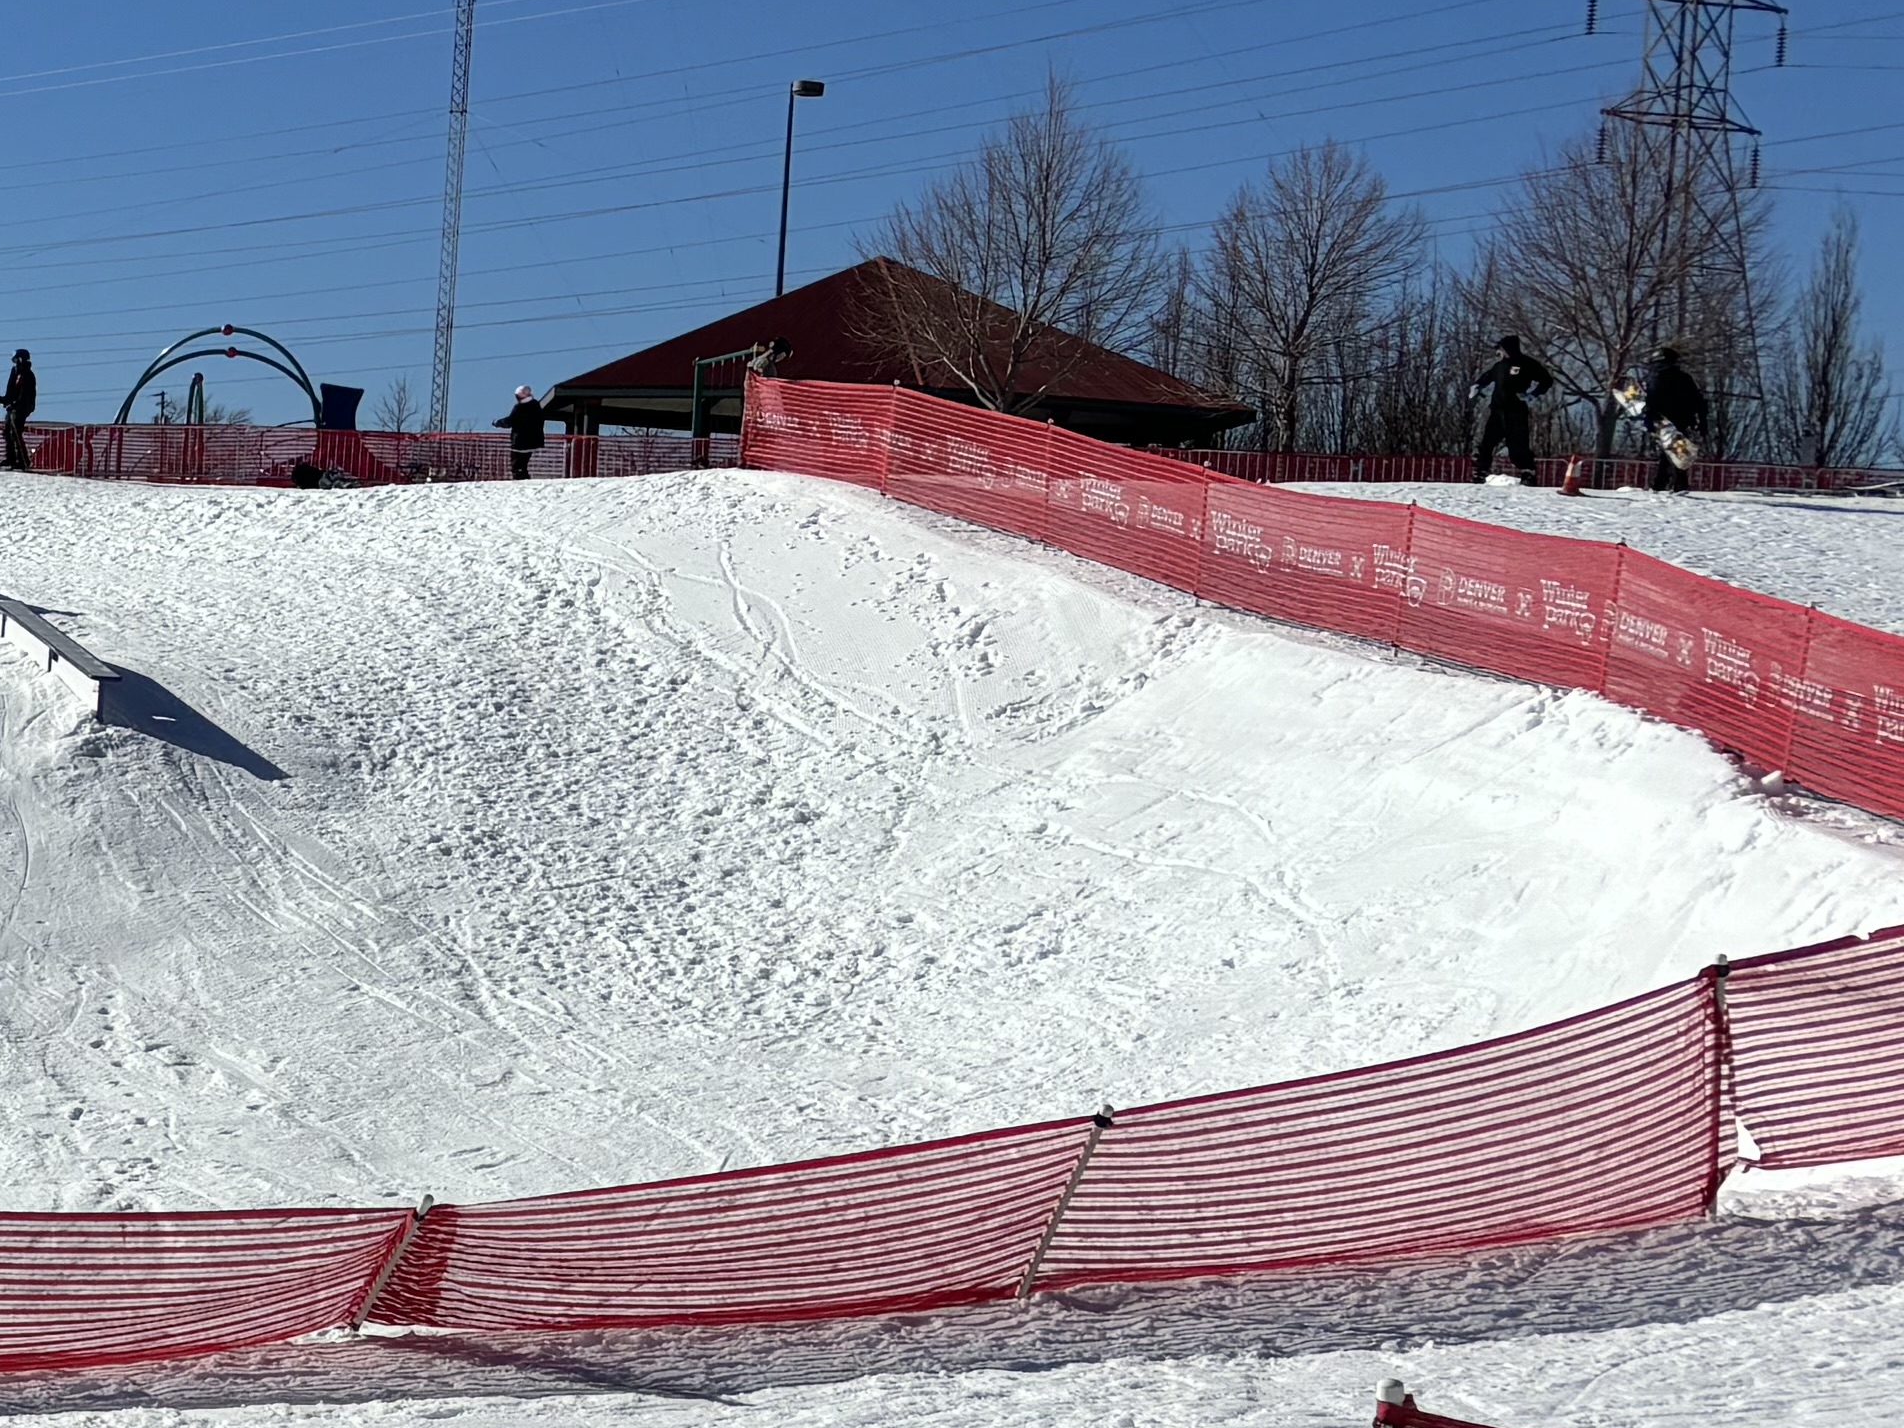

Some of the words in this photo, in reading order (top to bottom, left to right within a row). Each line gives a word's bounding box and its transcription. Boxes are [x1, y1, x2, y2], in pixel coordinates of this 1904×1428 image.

[1210, 509, 1264, 542] Winter
[1298, 545, 1342, 566] DENVER
[1371, 543, 1419, 573] Winter
[1457, 575, 1507, 603] DENVER
[1539, 578, 1591, 610] Winter
[1619, 611, 1669, 646] DENVER
[1701, 627, 1753, 668] Winter
